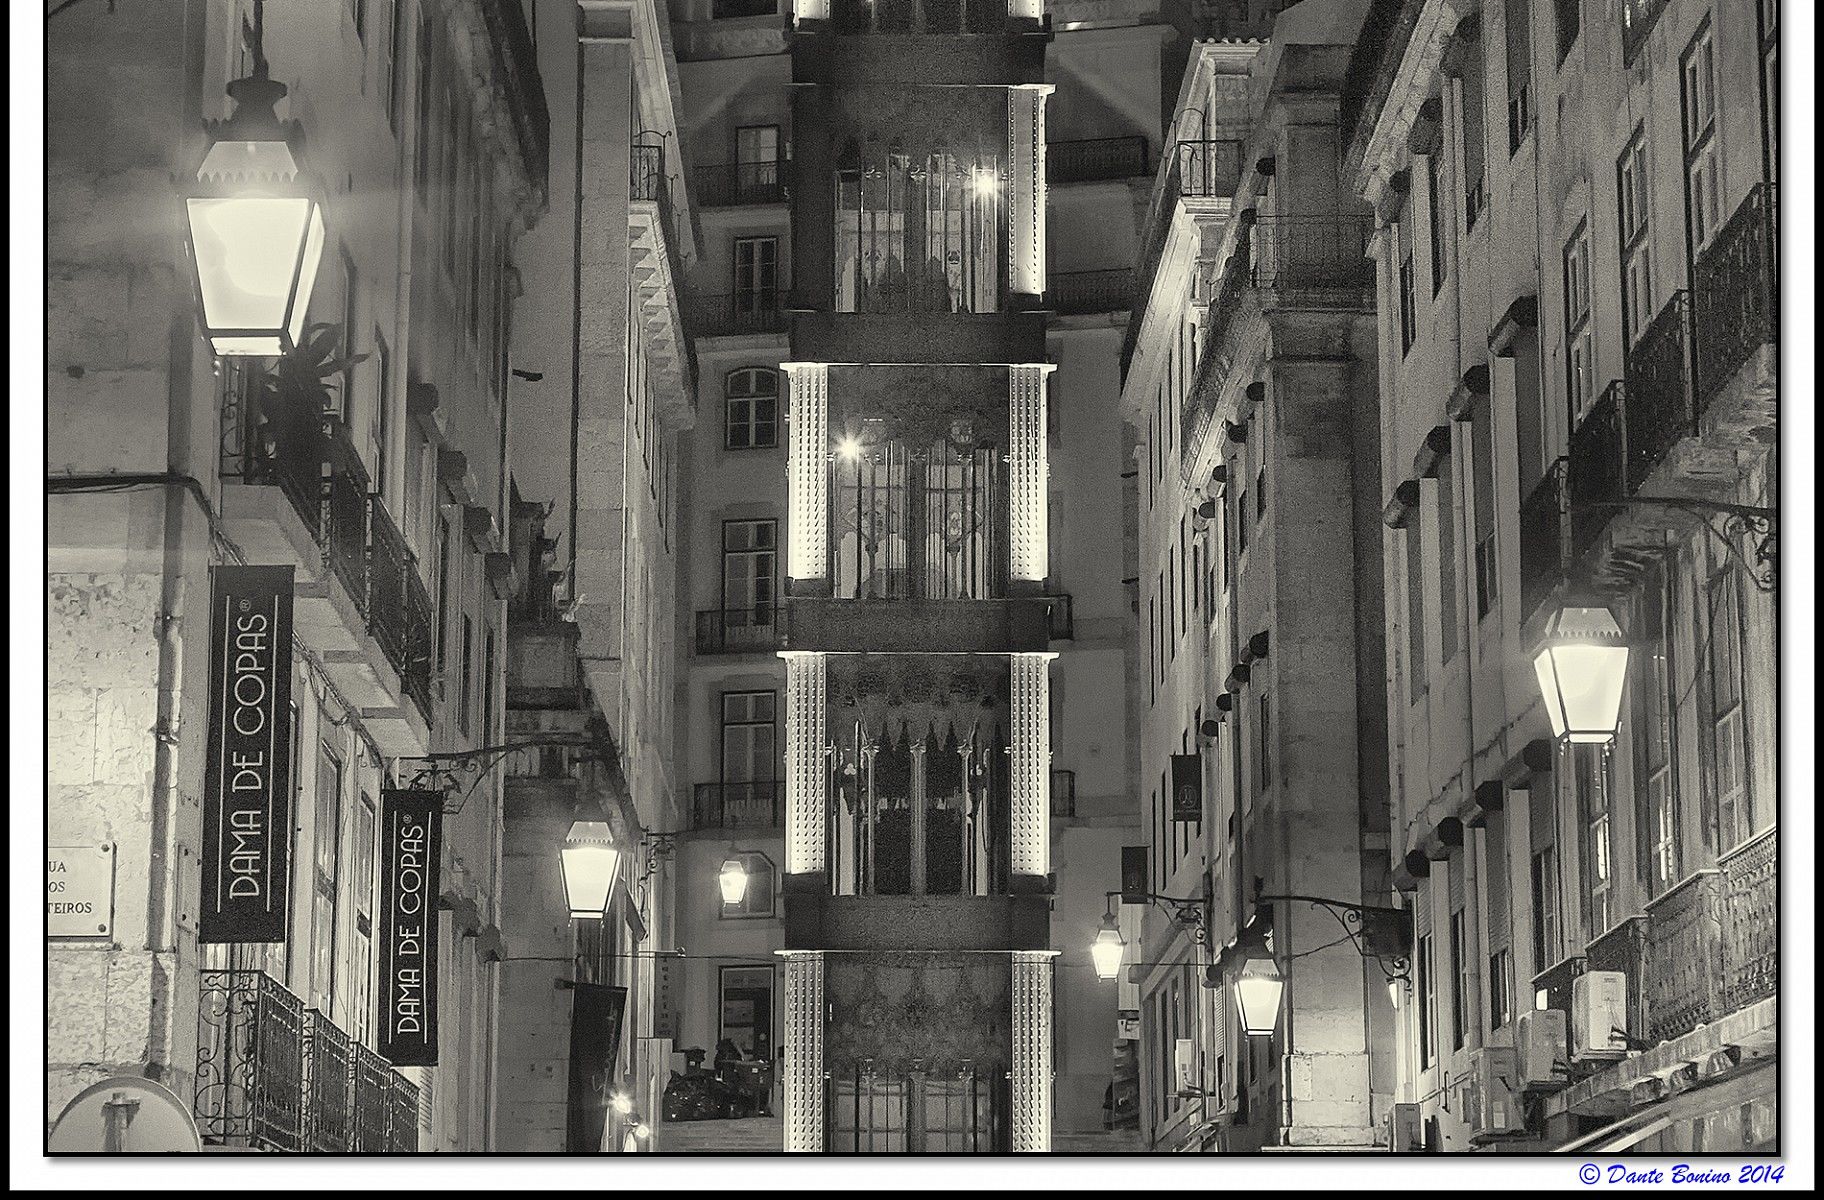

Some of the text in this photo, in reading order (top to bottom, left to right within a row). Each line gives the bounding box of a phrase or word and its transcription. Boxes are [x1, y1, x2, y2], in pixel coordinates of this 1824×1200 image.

[232, 751, 263, 793] DE
[229, 810, 262, 900] DAMA
[399, 925, 420, 956] DE
[397, 969, 420, 1035] DAMA
